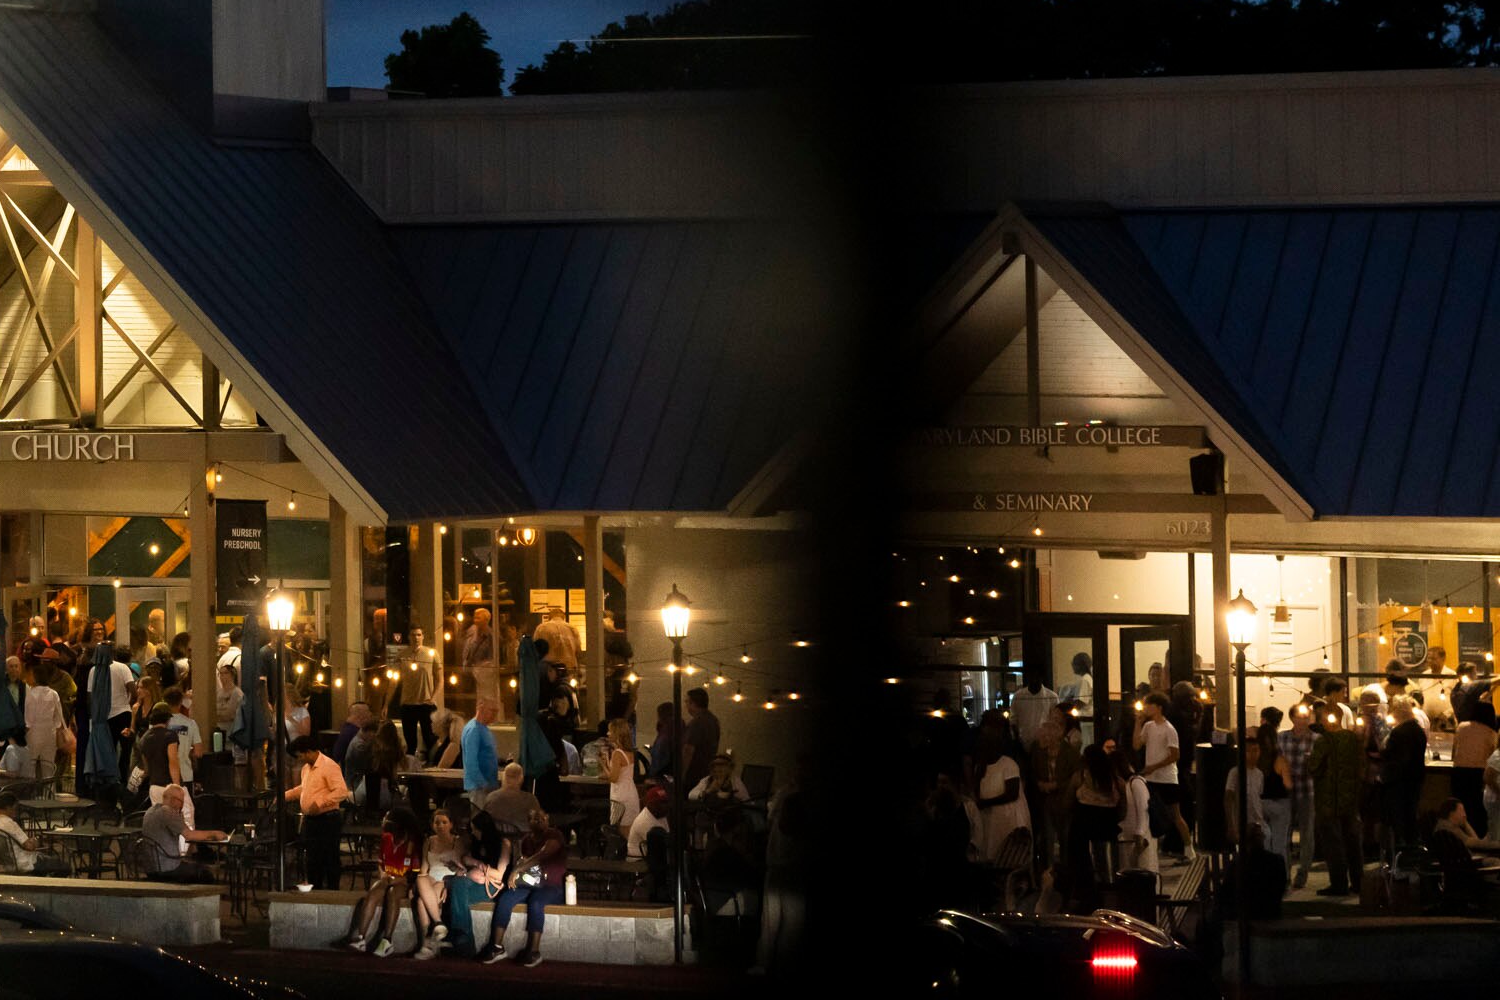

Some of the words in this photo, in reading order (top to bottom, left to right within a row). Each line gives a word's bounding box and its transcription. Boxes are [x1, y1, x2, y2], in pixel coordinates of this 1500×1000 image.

[906, 427, 1012, 446] ARYLAND
[1019, 427, 1067, 445] BIBLE
[1075, 427, 1162, 446] COLLEGE
[11, 434, 135, 461] CHURCH
[972, 494, 987, 512] &
[995, 494, 1094, 512] SEMINARY
[231, 528, 261, 538] NURSERY
[224, 540, 261, 550] PRESCHOOL
